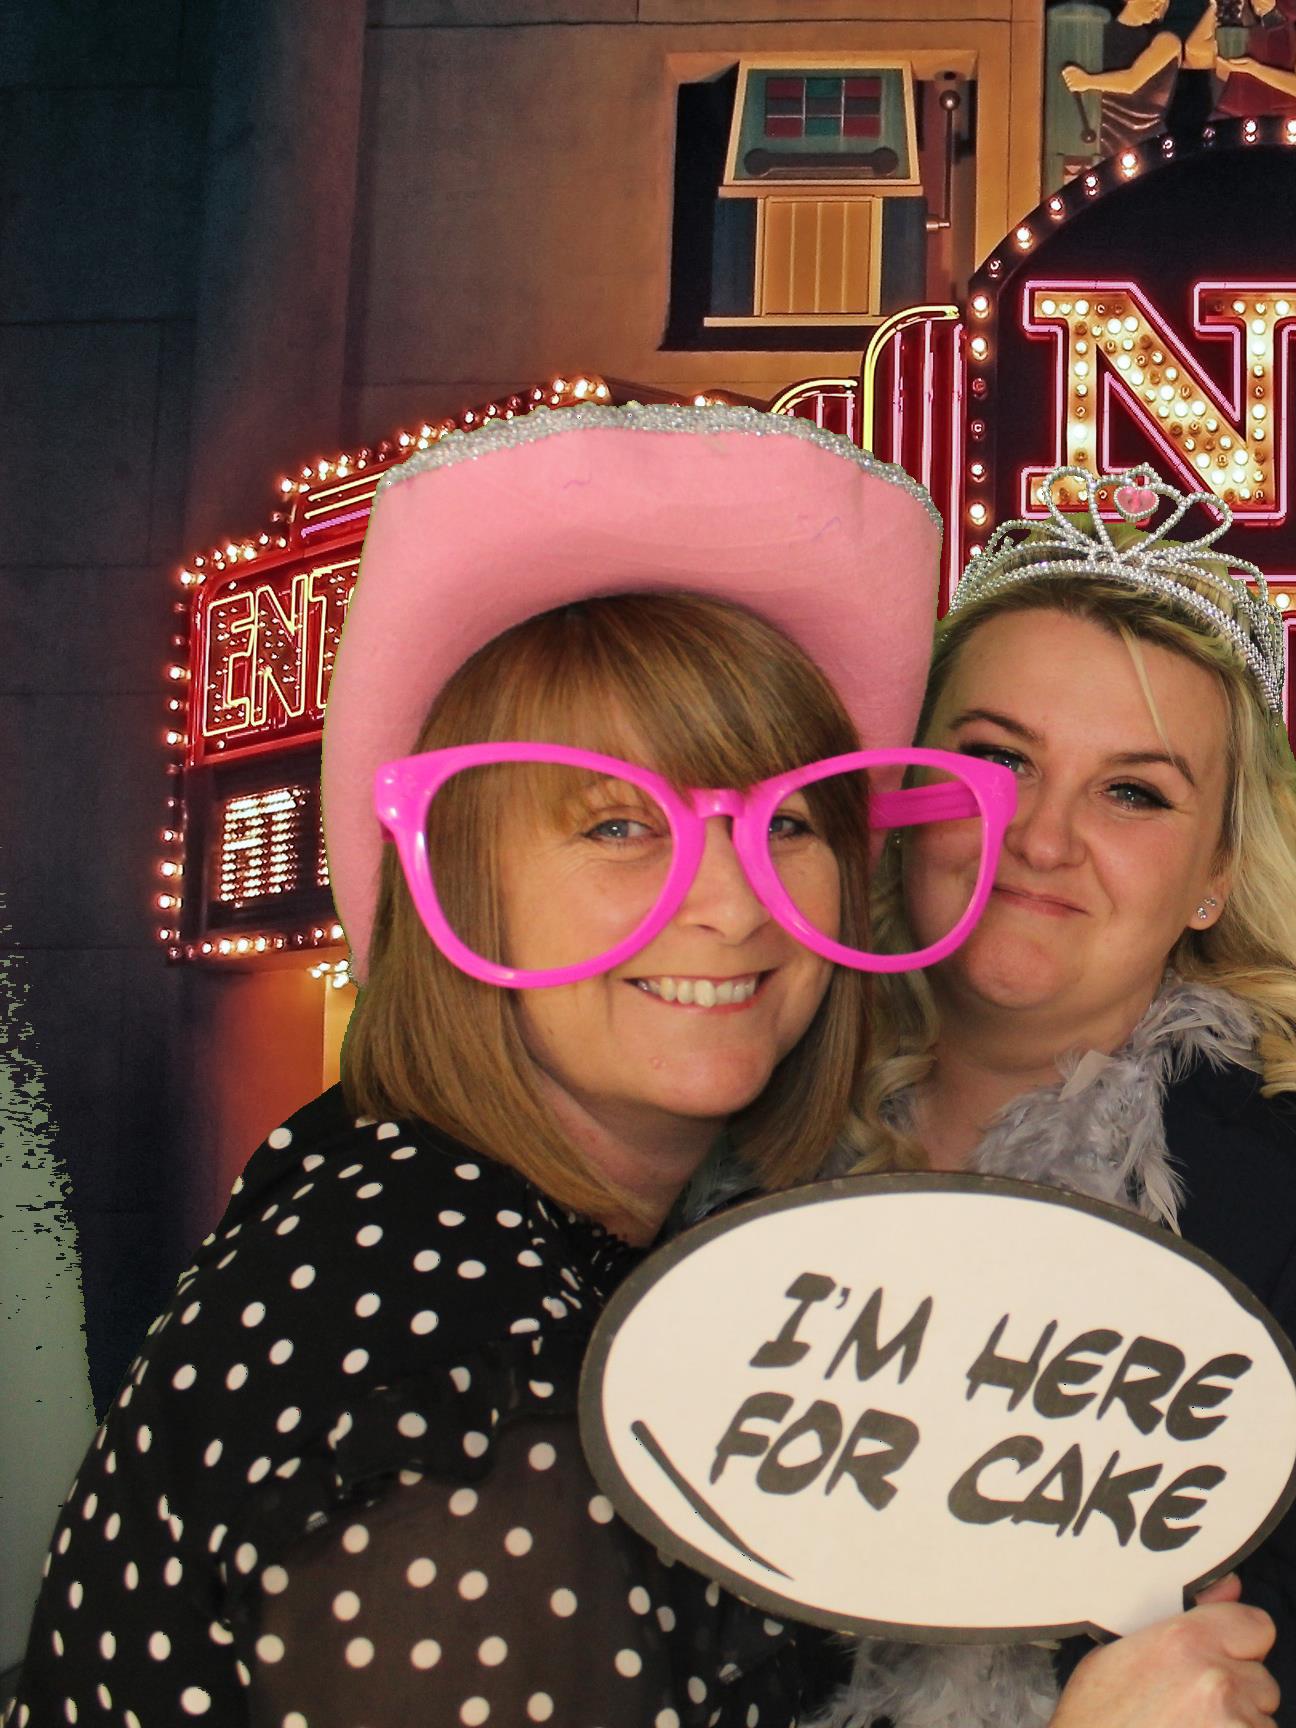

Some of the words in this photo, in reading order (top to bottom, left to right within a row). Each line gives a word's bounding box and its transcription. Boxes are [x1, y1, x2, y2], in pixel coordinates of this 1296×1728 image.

[749, 1272, 933, 1384] I'M
[966, 1313, 1252, 1441] HERE
[709, 1392, 920, 1511] FOR
[948, 1434, 1227, 1552] CAKE
